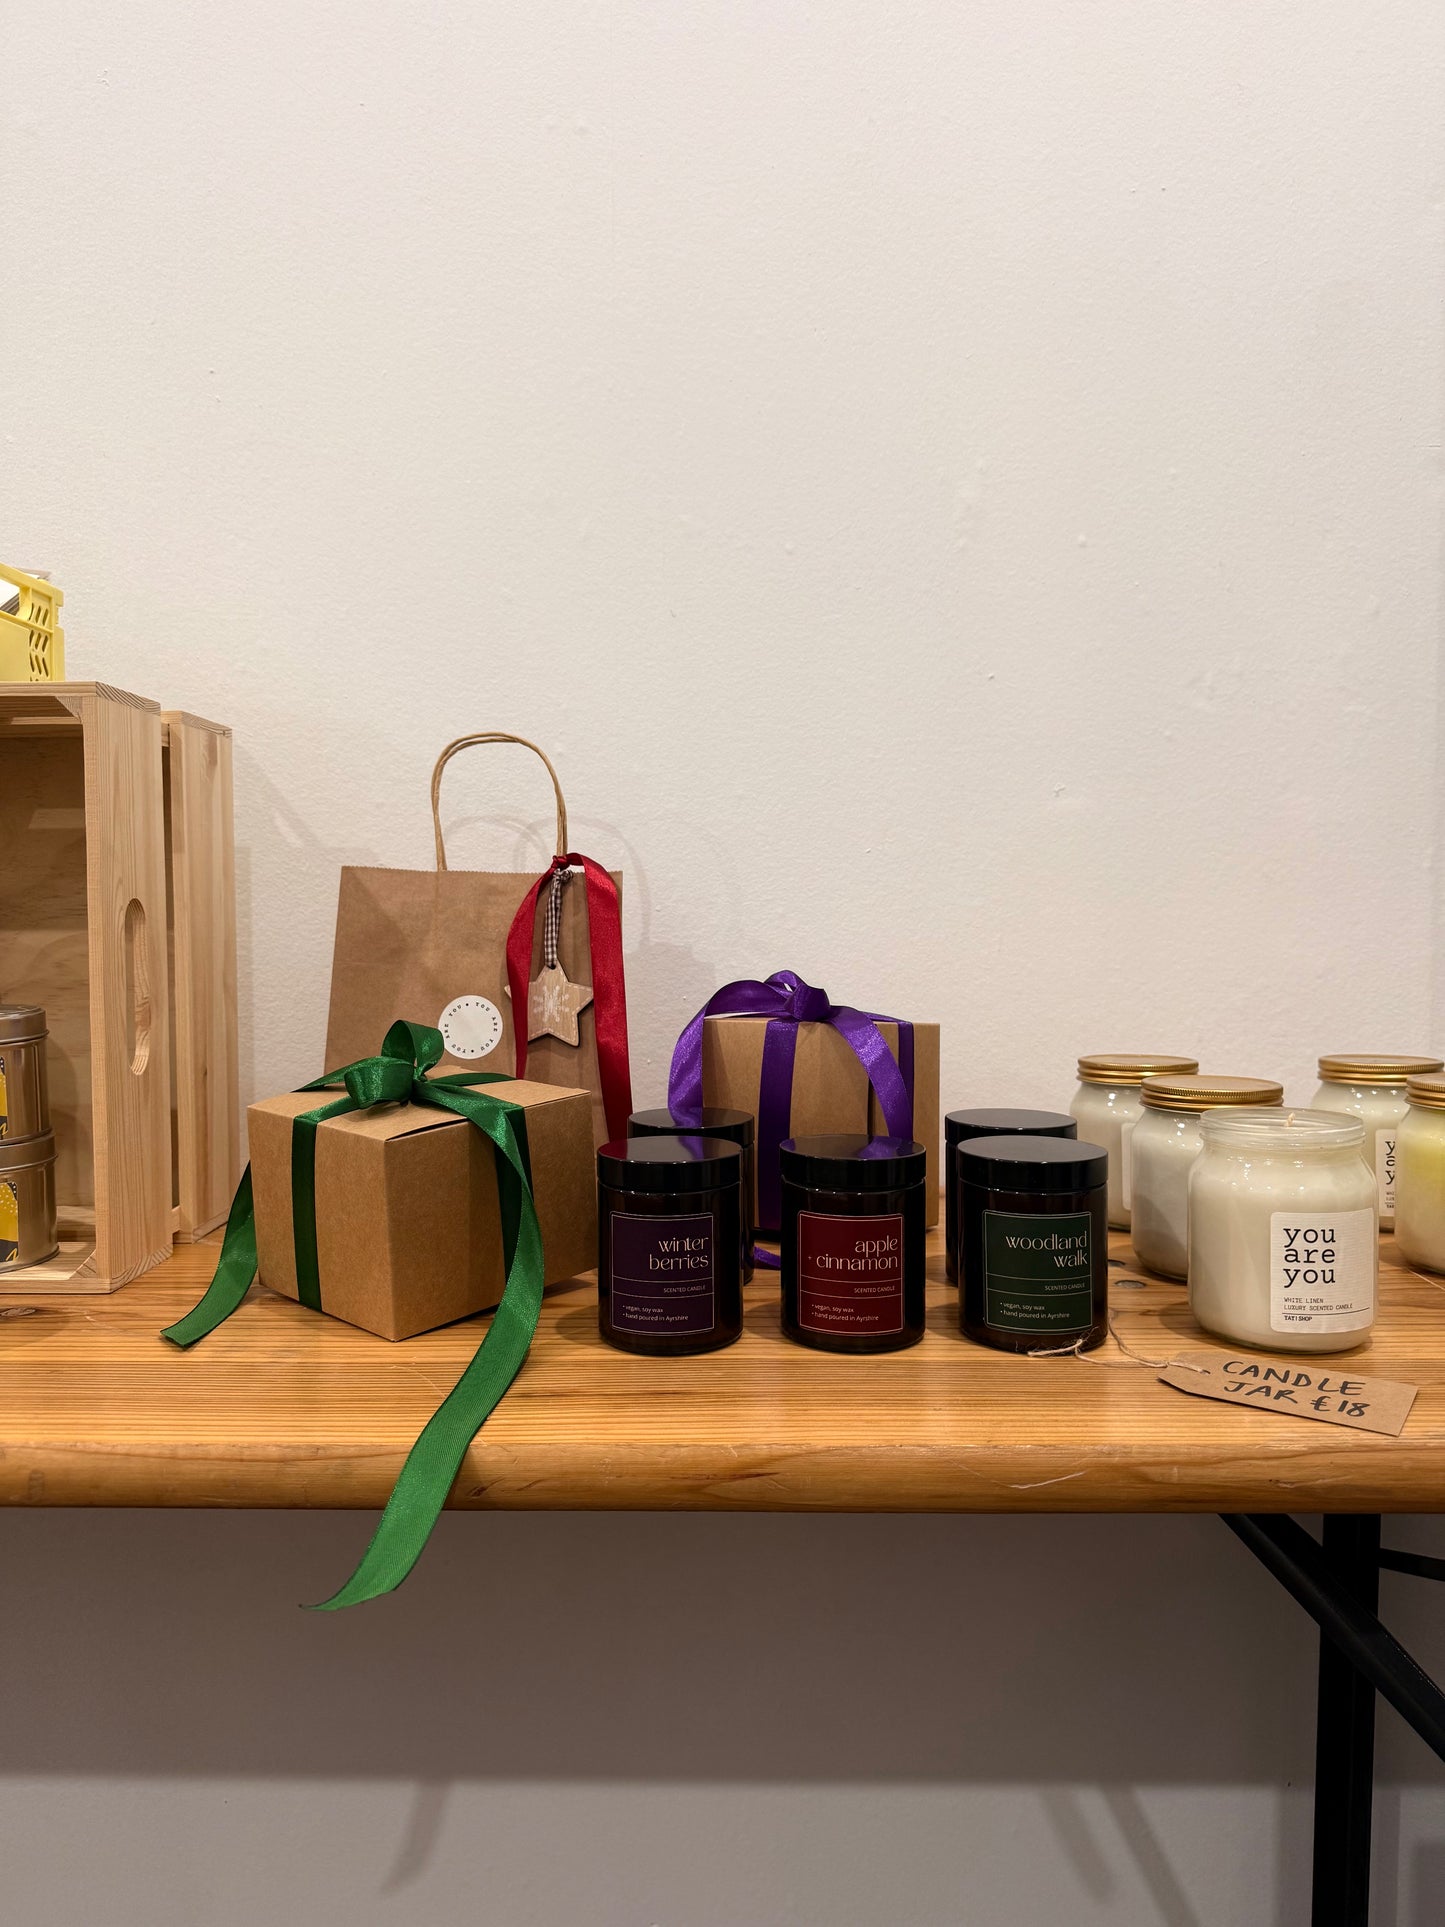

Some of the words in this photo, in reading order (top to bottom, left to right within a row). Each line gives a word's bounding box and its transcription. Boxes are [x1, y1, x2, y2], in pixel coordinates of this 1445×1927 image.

[658, 1237, 709, 1252] winter
[854, 1235, 898, 1257] apple
[1005, 1231, 1087, 1250] woodland
[1283, 1228, 1336, 1248] you
[649, 1254, 709, 1270] berries
[816, 1254, 898, 1271] cinnamon
[1053, 1250, 1088, 1268] walk
[1284, 1249, 1335, 1264] are
[1283, 1268, 1336, 1288] you
[687, 1284, 706, 1292] CANDLE
[877, 1285, 895, 1293] CANDLE
[1222, 1361, 1367, 1396] CANDLE
[1223, 1380, 1299, 1404] JAR
